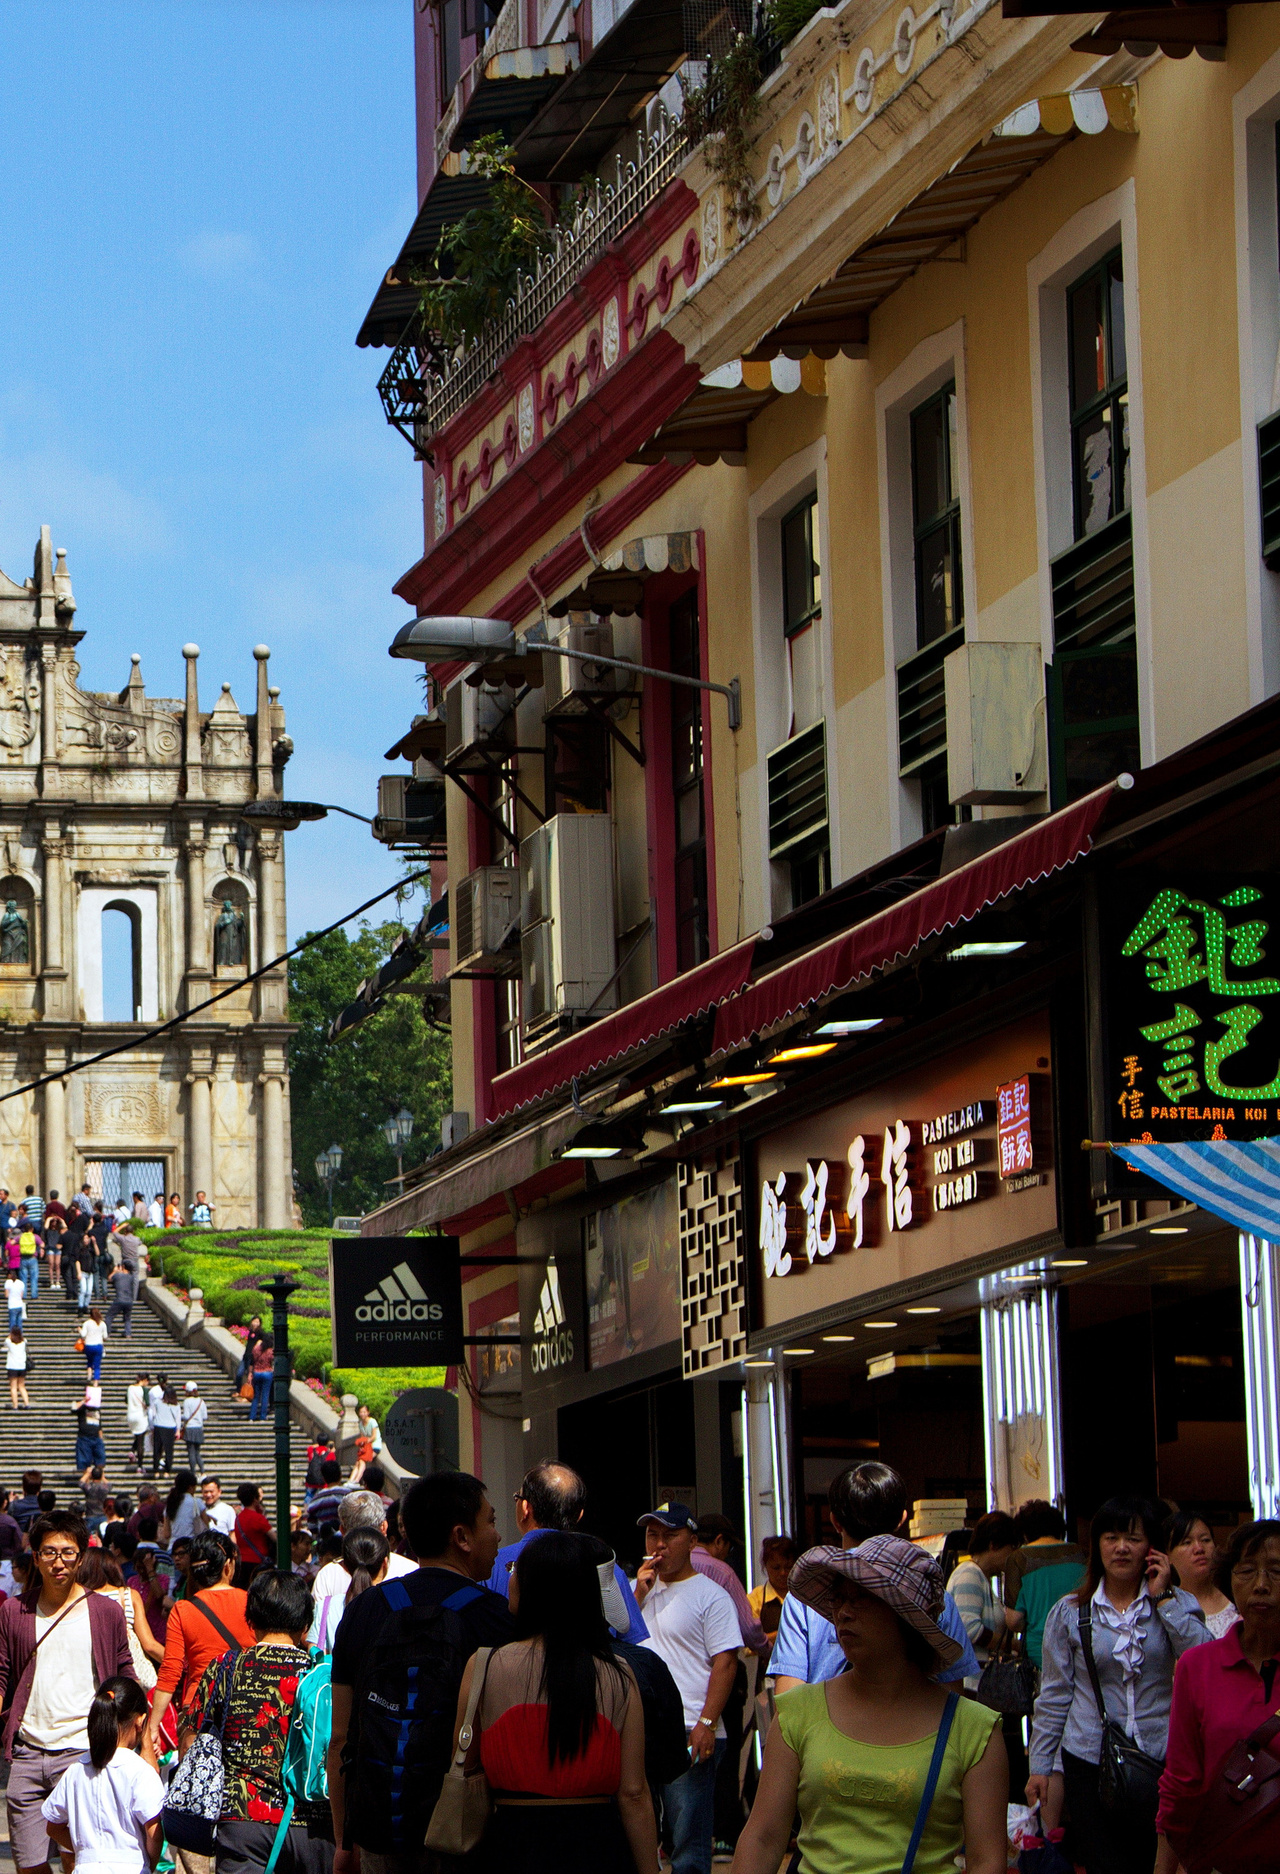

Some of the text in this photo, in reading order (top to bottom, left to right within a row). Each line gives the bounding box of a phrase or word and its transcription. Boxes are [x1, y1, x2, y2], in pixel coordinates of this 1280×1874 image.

[1118, 1055, 1144, 1119] 手信
[922, 1102, 984, 1146] PASTELARIA
[1151, 1106, 1235, 1120] PASTELARIA
[1245, 1107, 1267, 1121] KOI
[933, 1139, 975, 1175] KOI KEI
[355, 1299, 444, 1322] adidas
[356, 1330, 445, 1342] PERFORMANCE
[531, 1324, 574, 1373] adidas
[838, 1776, 896, 1803] USA
